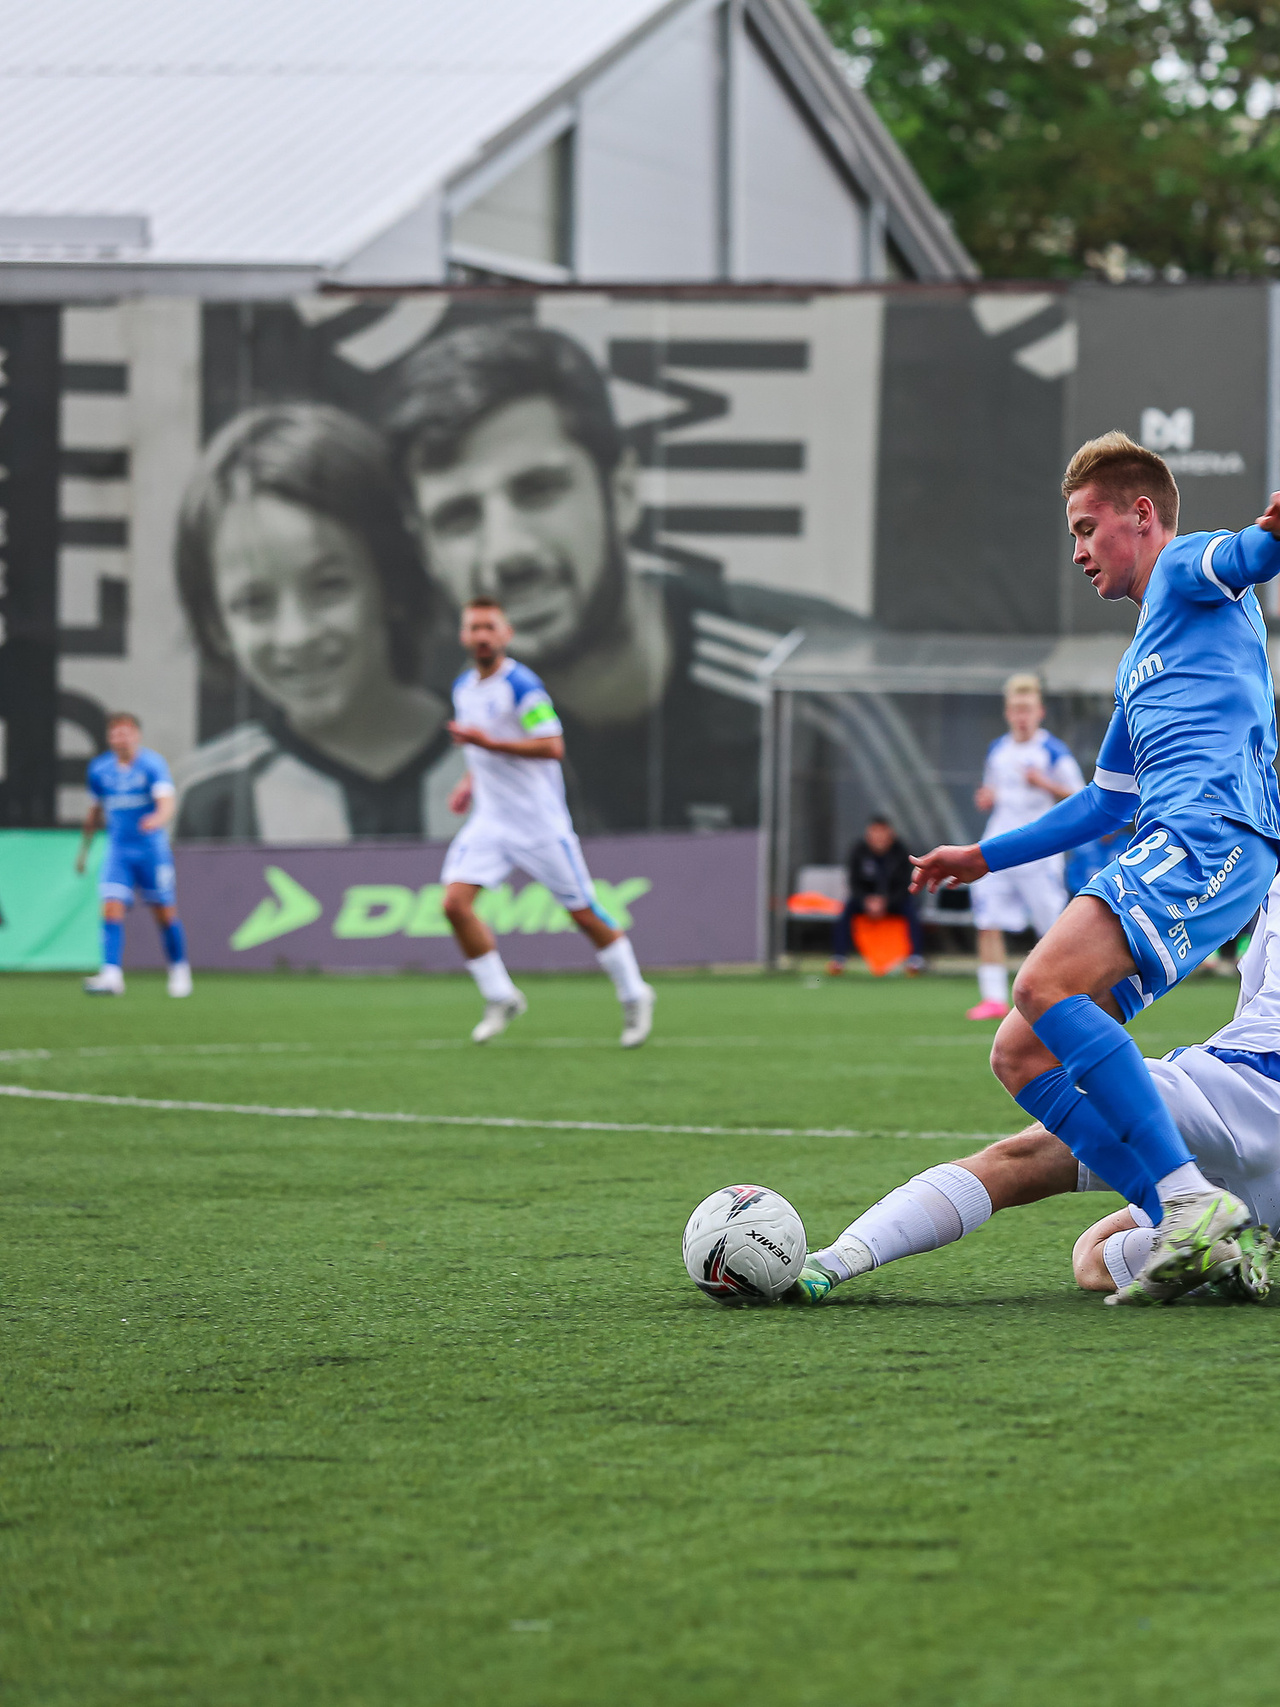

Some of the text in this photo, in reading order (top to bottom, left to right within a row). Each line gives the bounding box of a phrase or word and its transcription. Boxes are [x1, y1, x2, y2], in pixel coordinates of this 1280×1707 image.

[1117, 830, 1189, 886] 81
[1184, 844, 1244, 914] BetBoom
[745, 1230, 792, 1266] DEMIX
